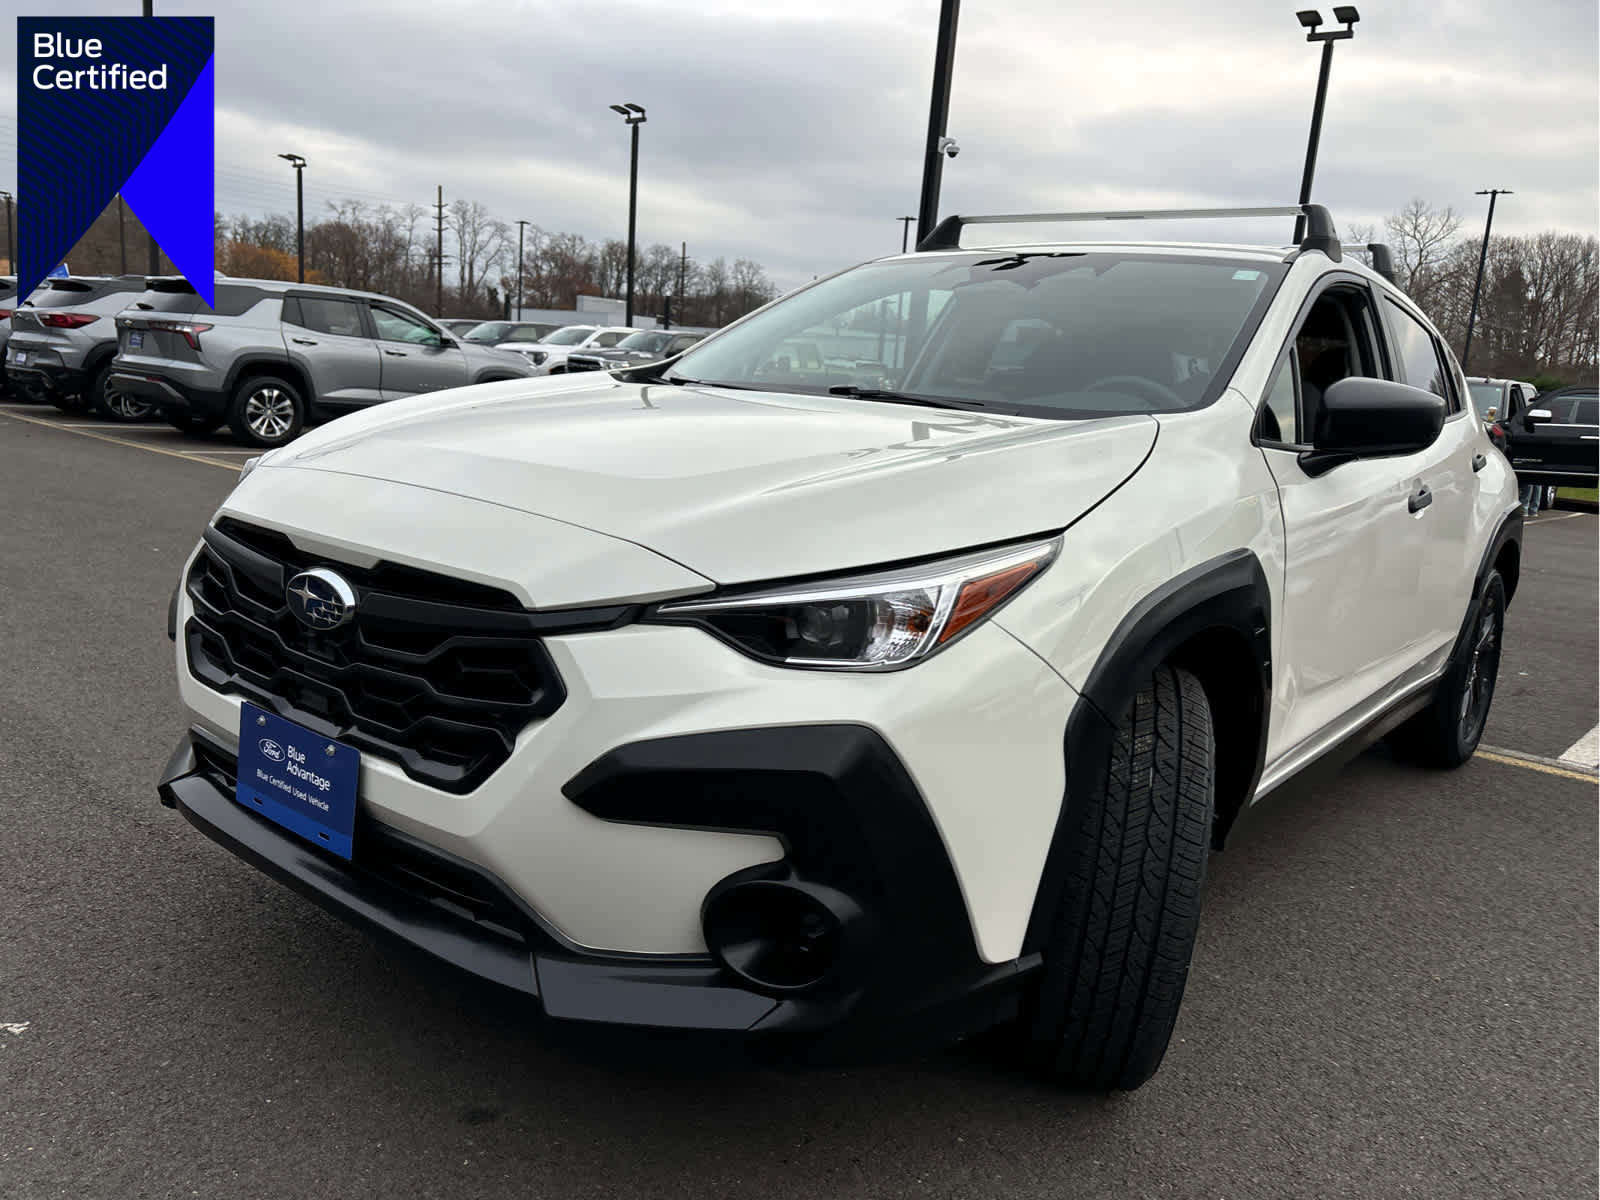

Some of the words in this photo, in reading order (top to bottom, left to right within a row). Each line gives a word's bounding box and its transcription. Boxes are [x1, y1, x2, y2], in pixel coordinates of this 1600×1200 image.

[263, 740, 280, 759] Ford
[287, 745, 306, 764] Blue
[286, 760, 331, 791] Advantage
[256, 768, 269, 782] Blue
[269, 775, 292, 795] Certified
[292, 787, 307, 801] Used
[308, 794, 329, 812] Vehicle
